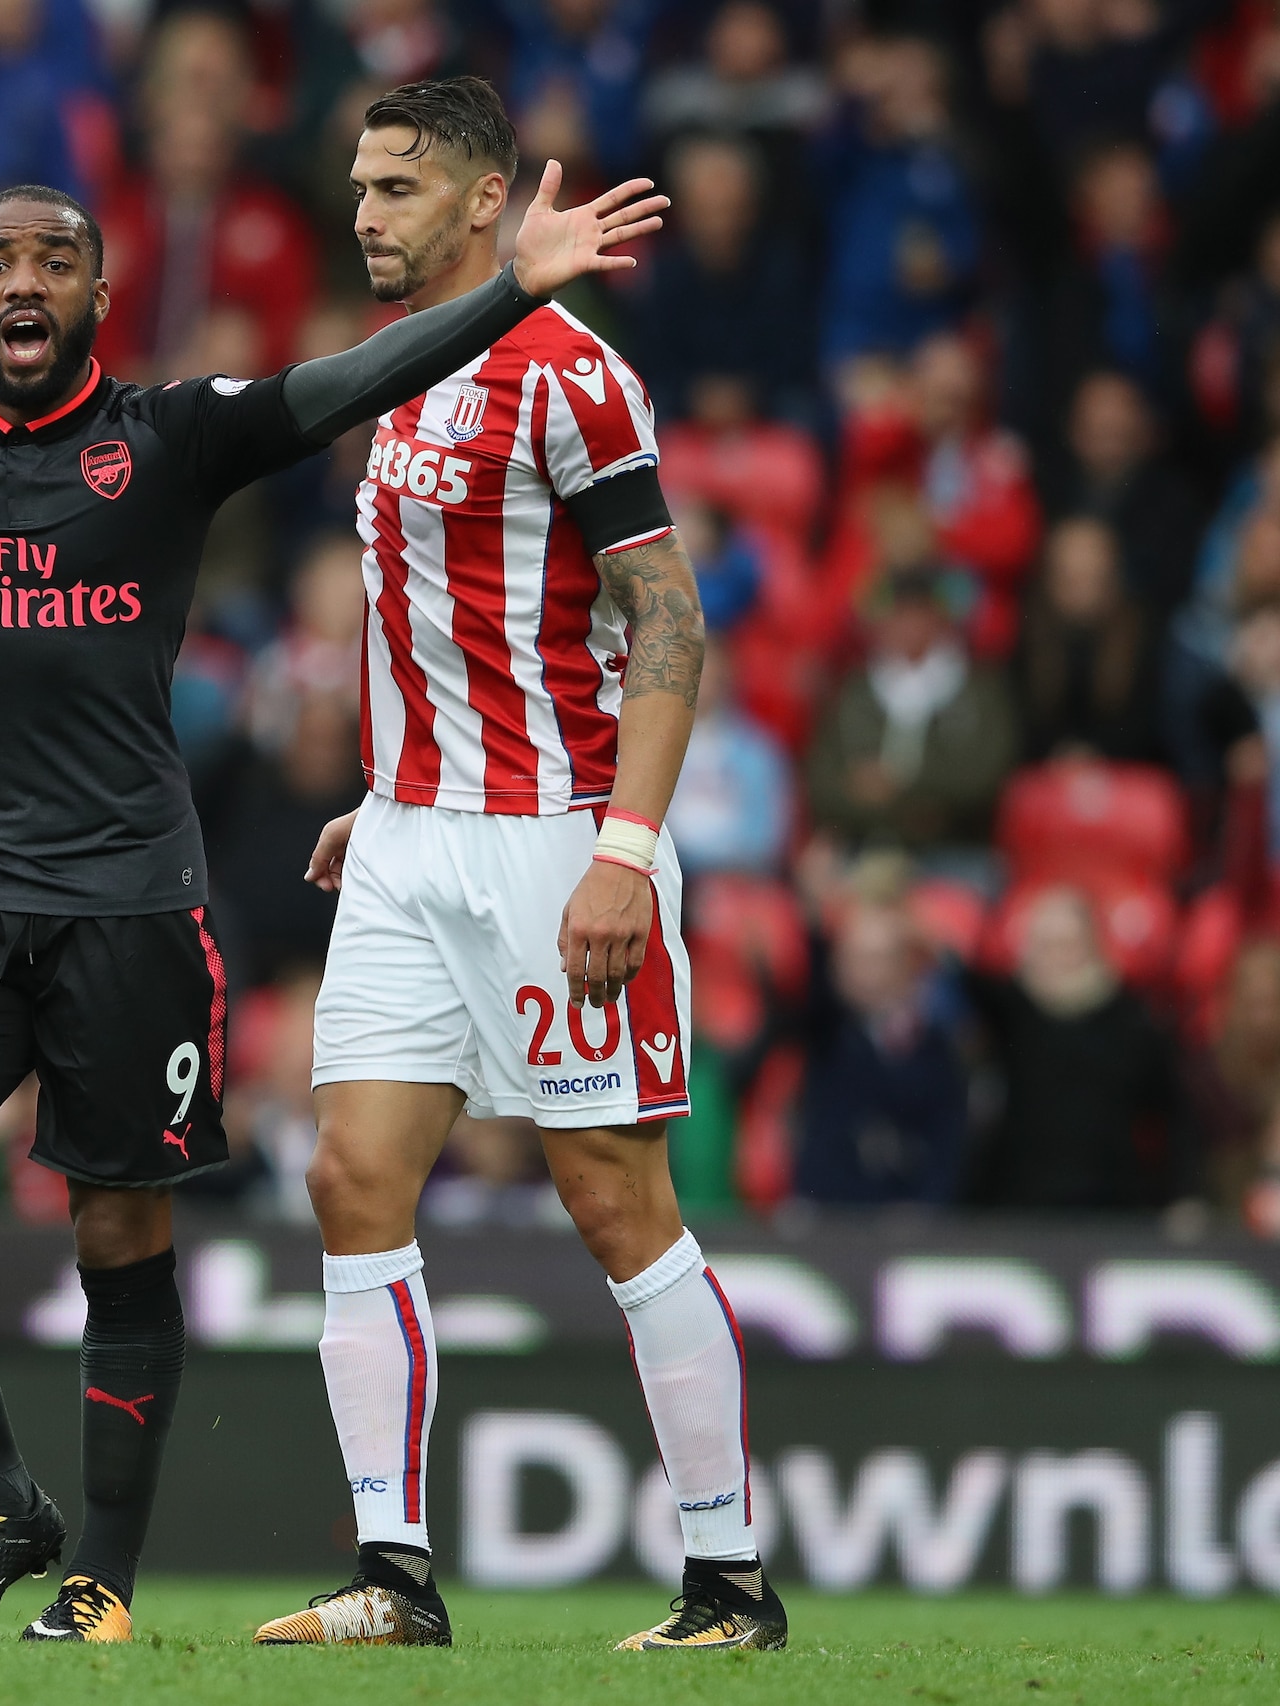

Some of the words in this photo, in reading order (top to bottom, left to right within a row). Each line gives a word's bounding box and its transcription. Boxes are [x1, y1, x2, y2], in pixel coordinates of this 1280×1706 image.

[461, 387, 485, 399] STOKE
[366, 438, 472, 505] et365
[516, 983, 621, 1066] 20
[166, 1041, 200, 1126] 9
[540, 1072, 621, 1095] macron
